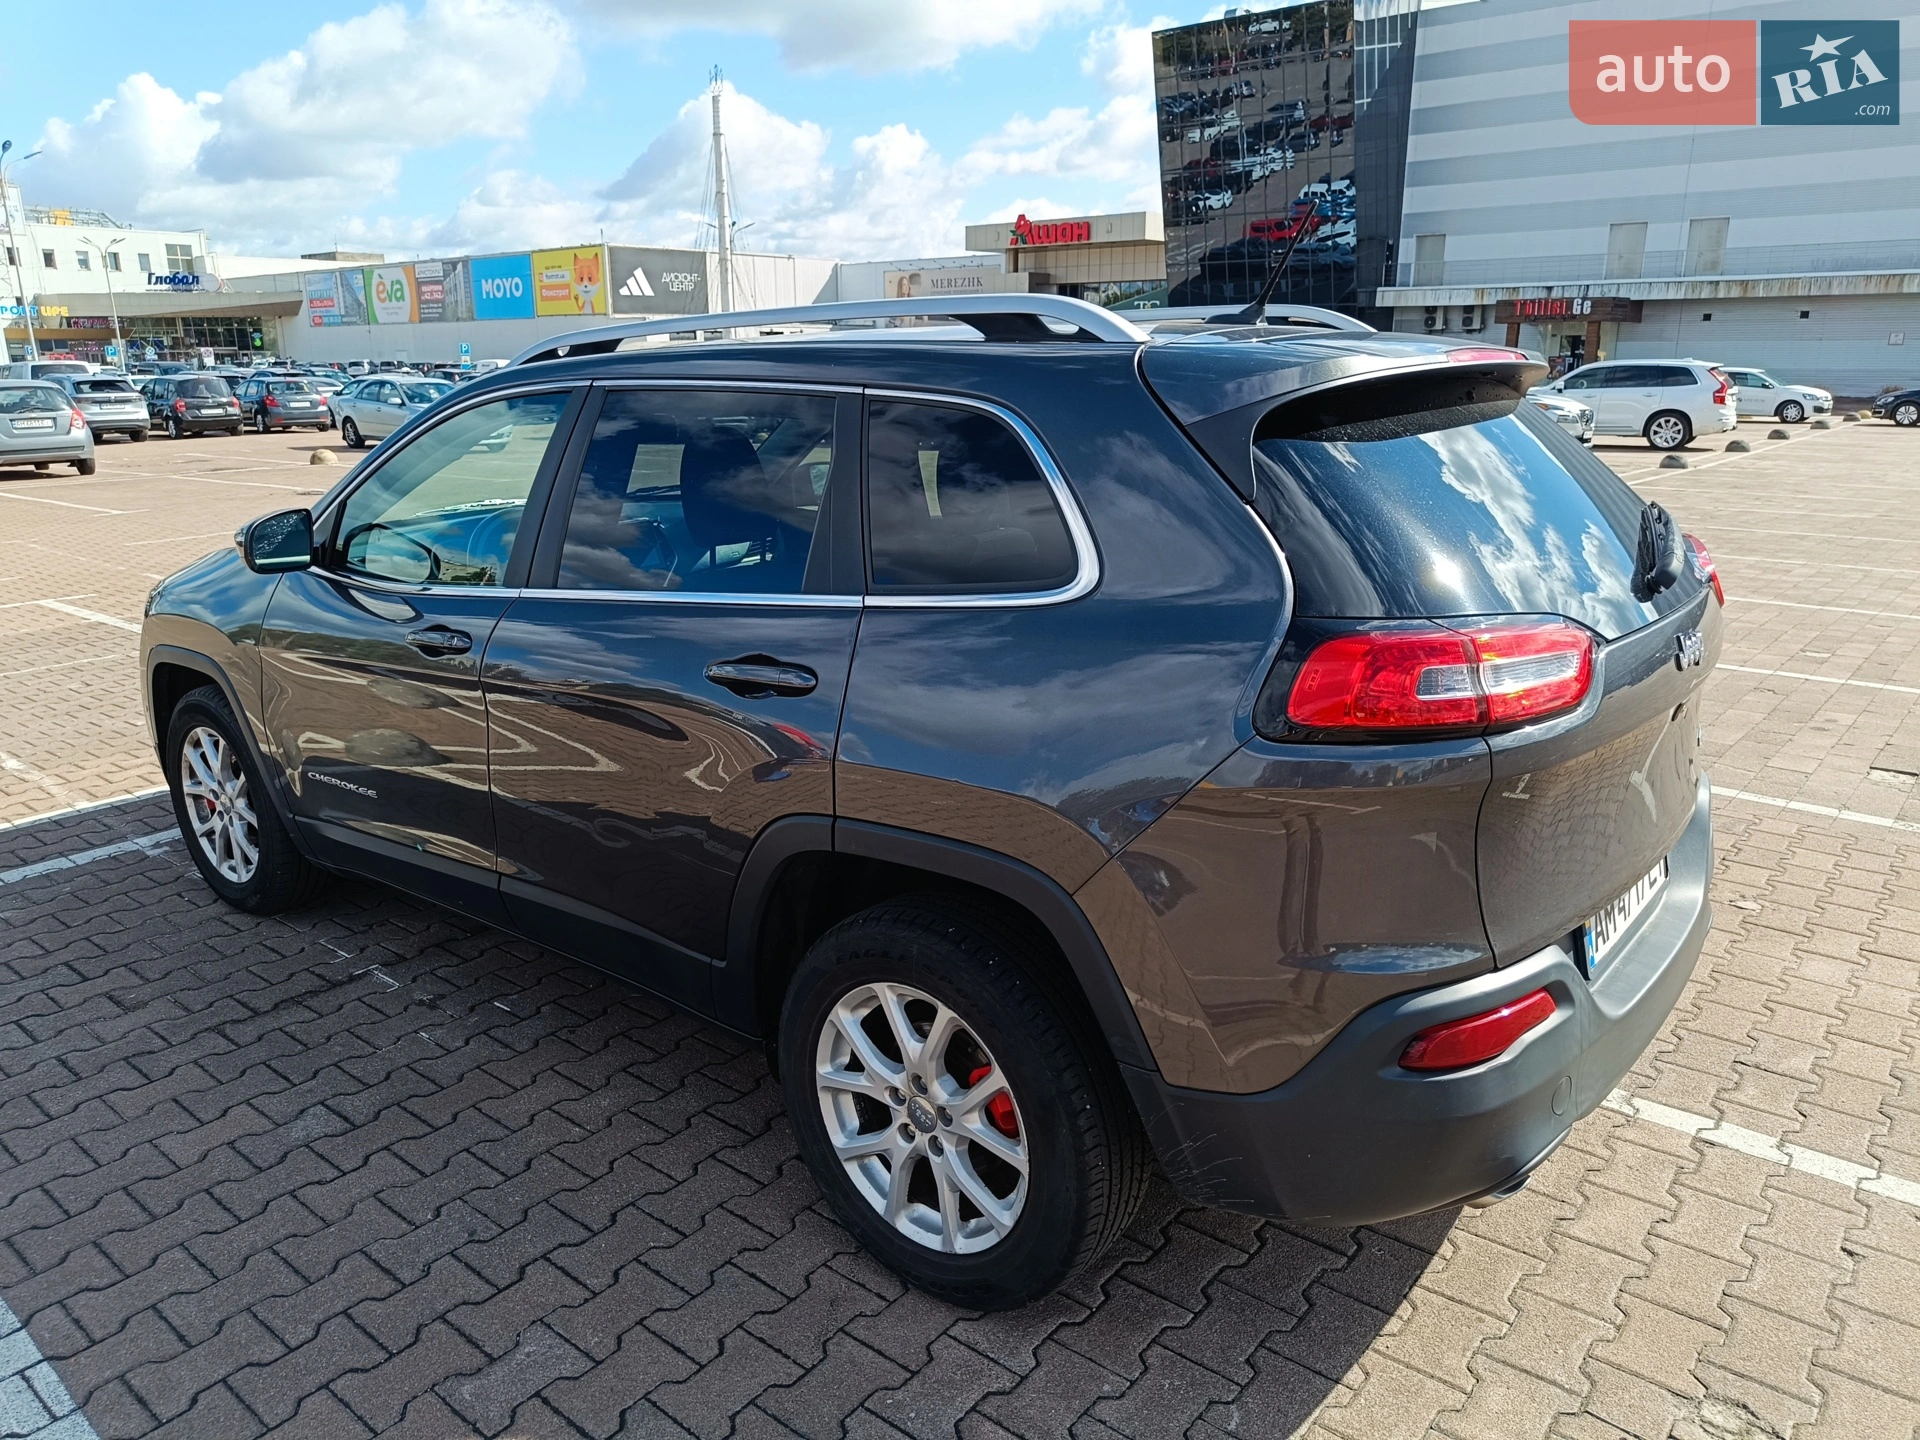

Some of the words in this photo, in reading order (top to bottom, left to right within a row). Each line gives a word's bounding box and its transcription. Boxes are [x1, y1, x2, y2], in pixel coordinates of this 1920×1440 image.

[147, 271, 200, 285] Глобал
[661, 272, 701, 283] ДИСКОНТ-
[481, 277, 523, 299] MOYO
[669, 281, 694, 292] ЦЕНТР
[308, 772, 378, 798] CHEROKEE
